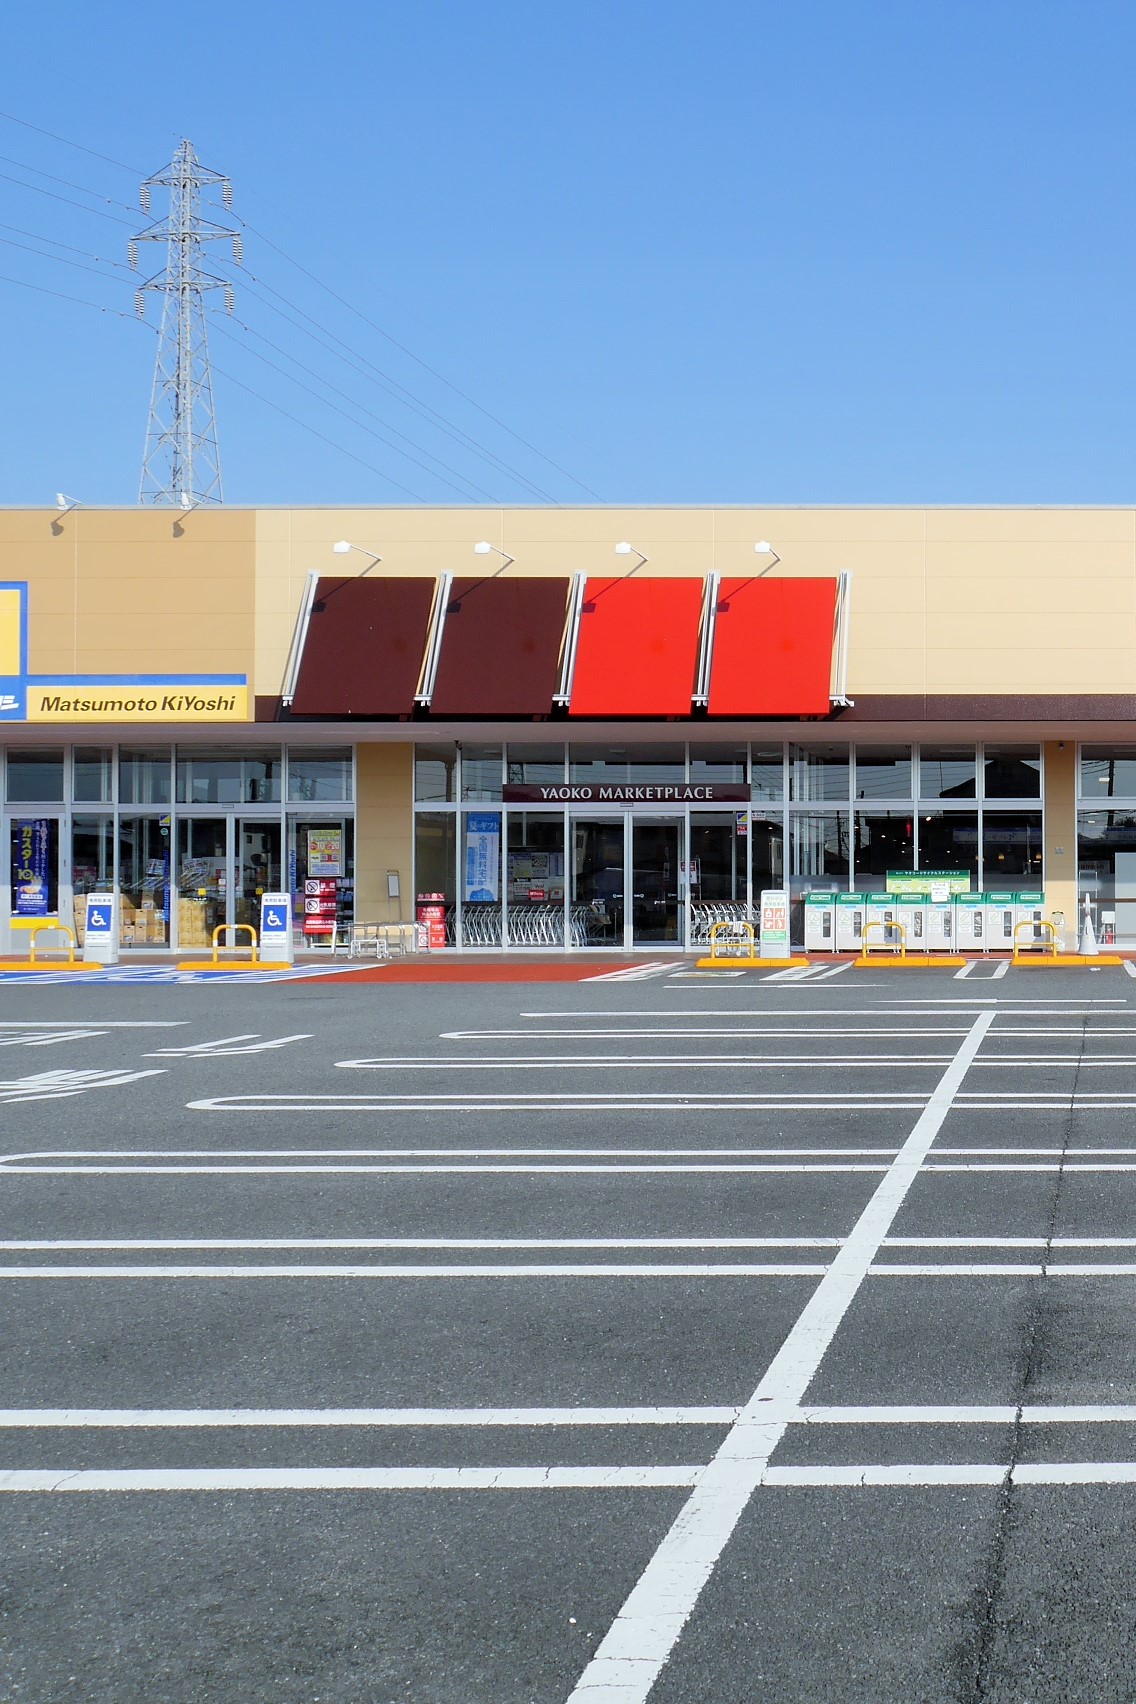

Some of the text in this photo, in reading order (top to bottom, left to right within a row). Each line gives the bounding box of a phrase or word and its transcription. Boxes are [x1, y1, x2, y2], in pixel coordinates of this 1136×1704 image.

[41, 695, 236, 712] Matsumoto KiYoshi
[540, 787, 713, 799] YAOKO MARKETPLACE
